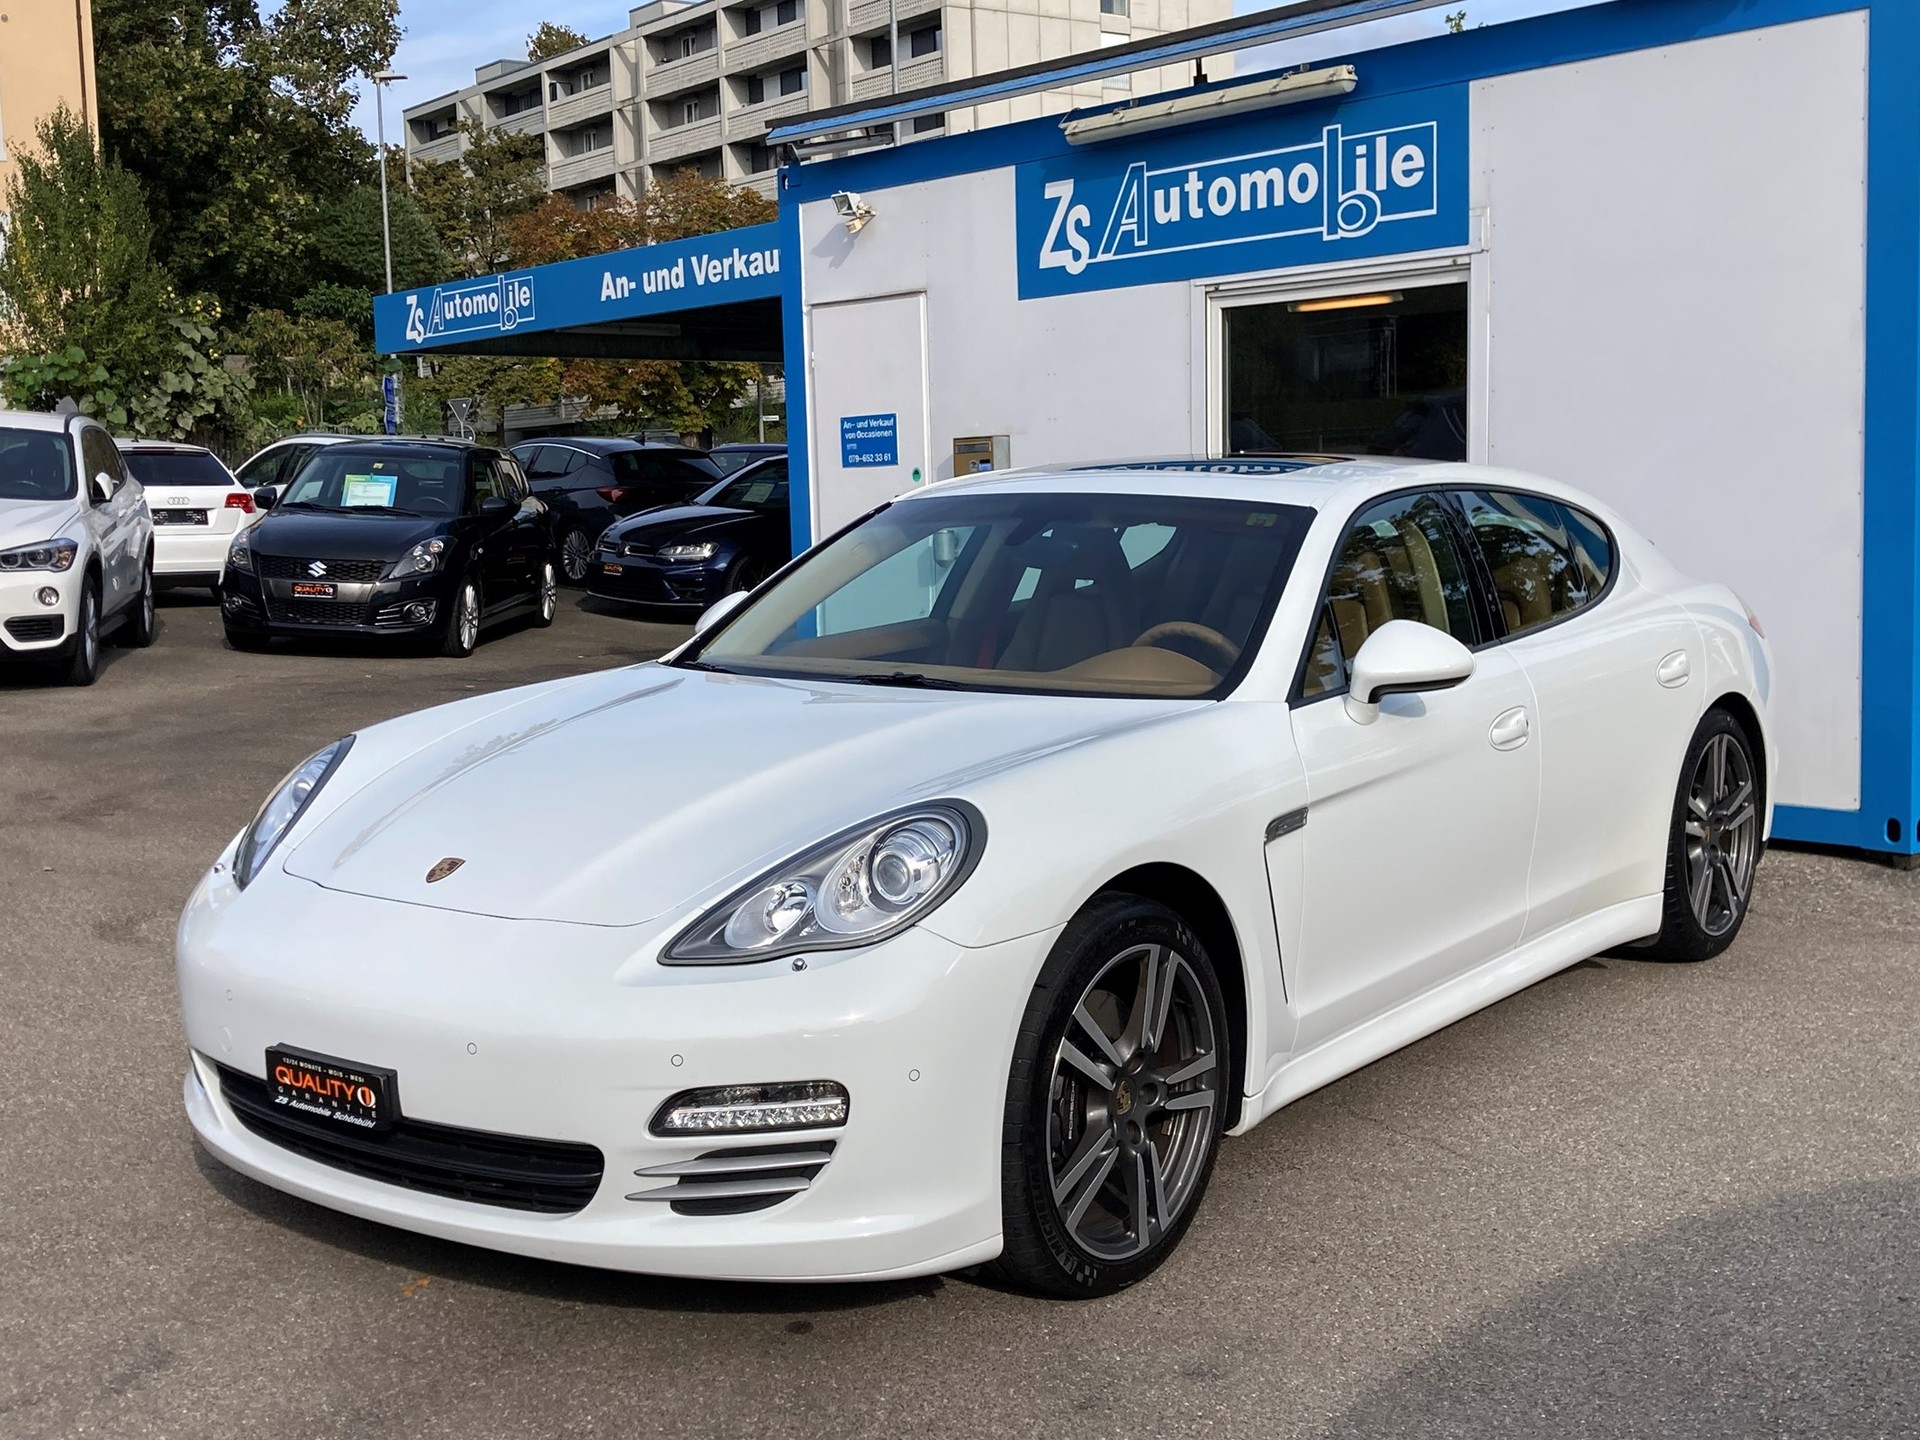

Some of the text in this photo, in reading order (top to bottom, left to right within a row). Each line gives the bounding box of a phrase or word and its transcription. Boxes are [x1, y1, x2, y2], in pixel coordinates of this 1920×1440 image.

[1098, 123, 1426, 258] Automobile
[600, 247, 781, 302] An- und Verkau
[426, 274, 531, 336] Automobile
[843, 418, 894, 429] An- und Verkauf
[856, 430, 893, 438] Occasionen
[874, 453, 883, 461] 33
[883, 453, 891, 461] 61
[275, 1066, 355, 1101] QUALITY
[299, 1061, 321, 1072] MONATE
[328, 1069, 343, 1078] MOIS
[350, 1074, 365, 1083] MESI
[277, 1086, 377, 1118] GARANTIE
[289, 1100, 331, 1117] Automobile
[333, 1111, 376, 1129] Schönbühl
